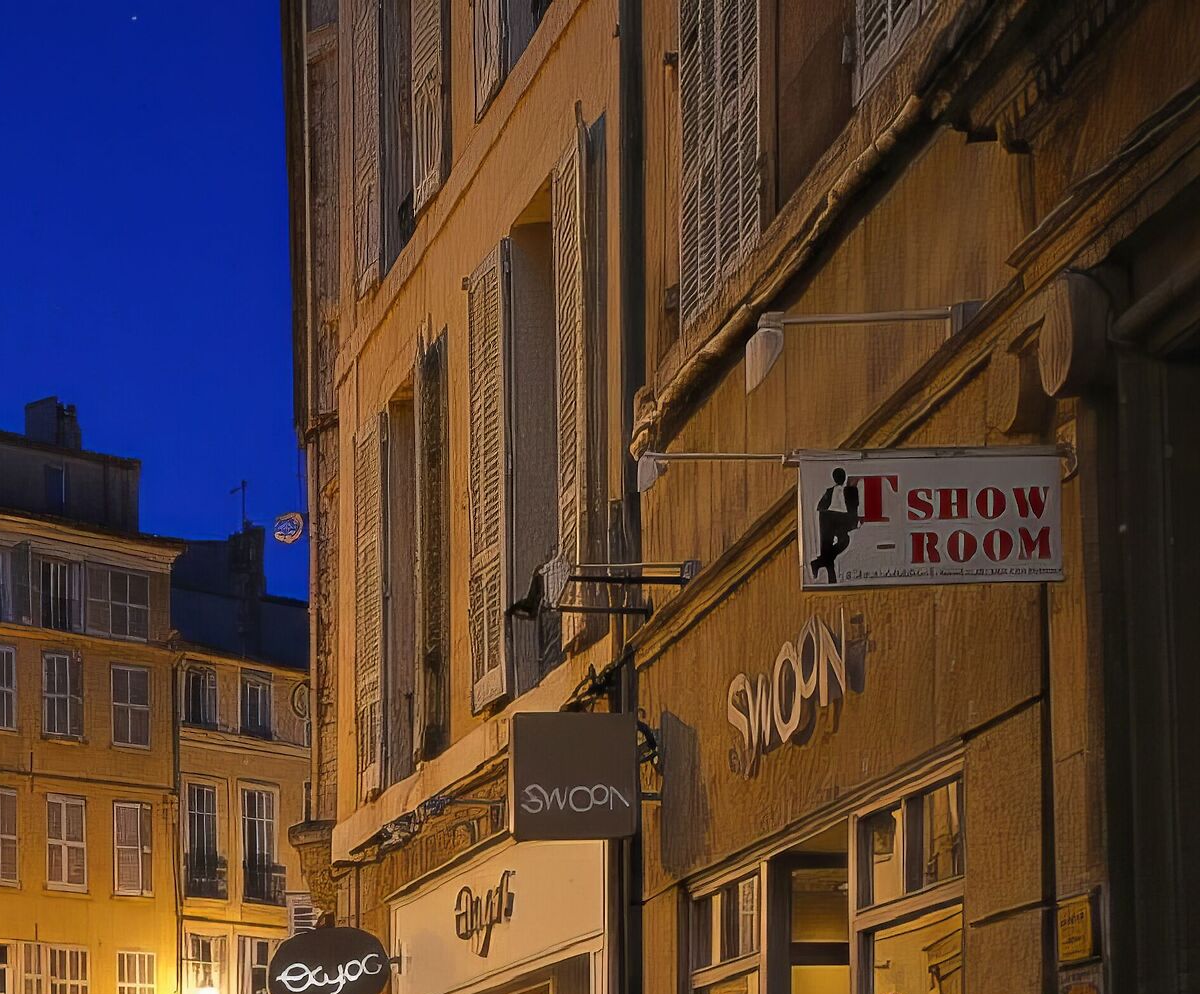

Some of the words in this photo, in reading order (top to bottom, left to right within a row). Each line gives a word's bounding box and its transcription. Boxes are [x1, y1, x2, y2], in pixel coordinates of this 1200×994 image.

[847, 474, 899, 523] T
[906, 486, 1050, 521] SHOW
[910, 526, 1052, 564] ROOM
[727, 603, 847, 780] SWOON
[520, 782, 630, 815] SWOON
